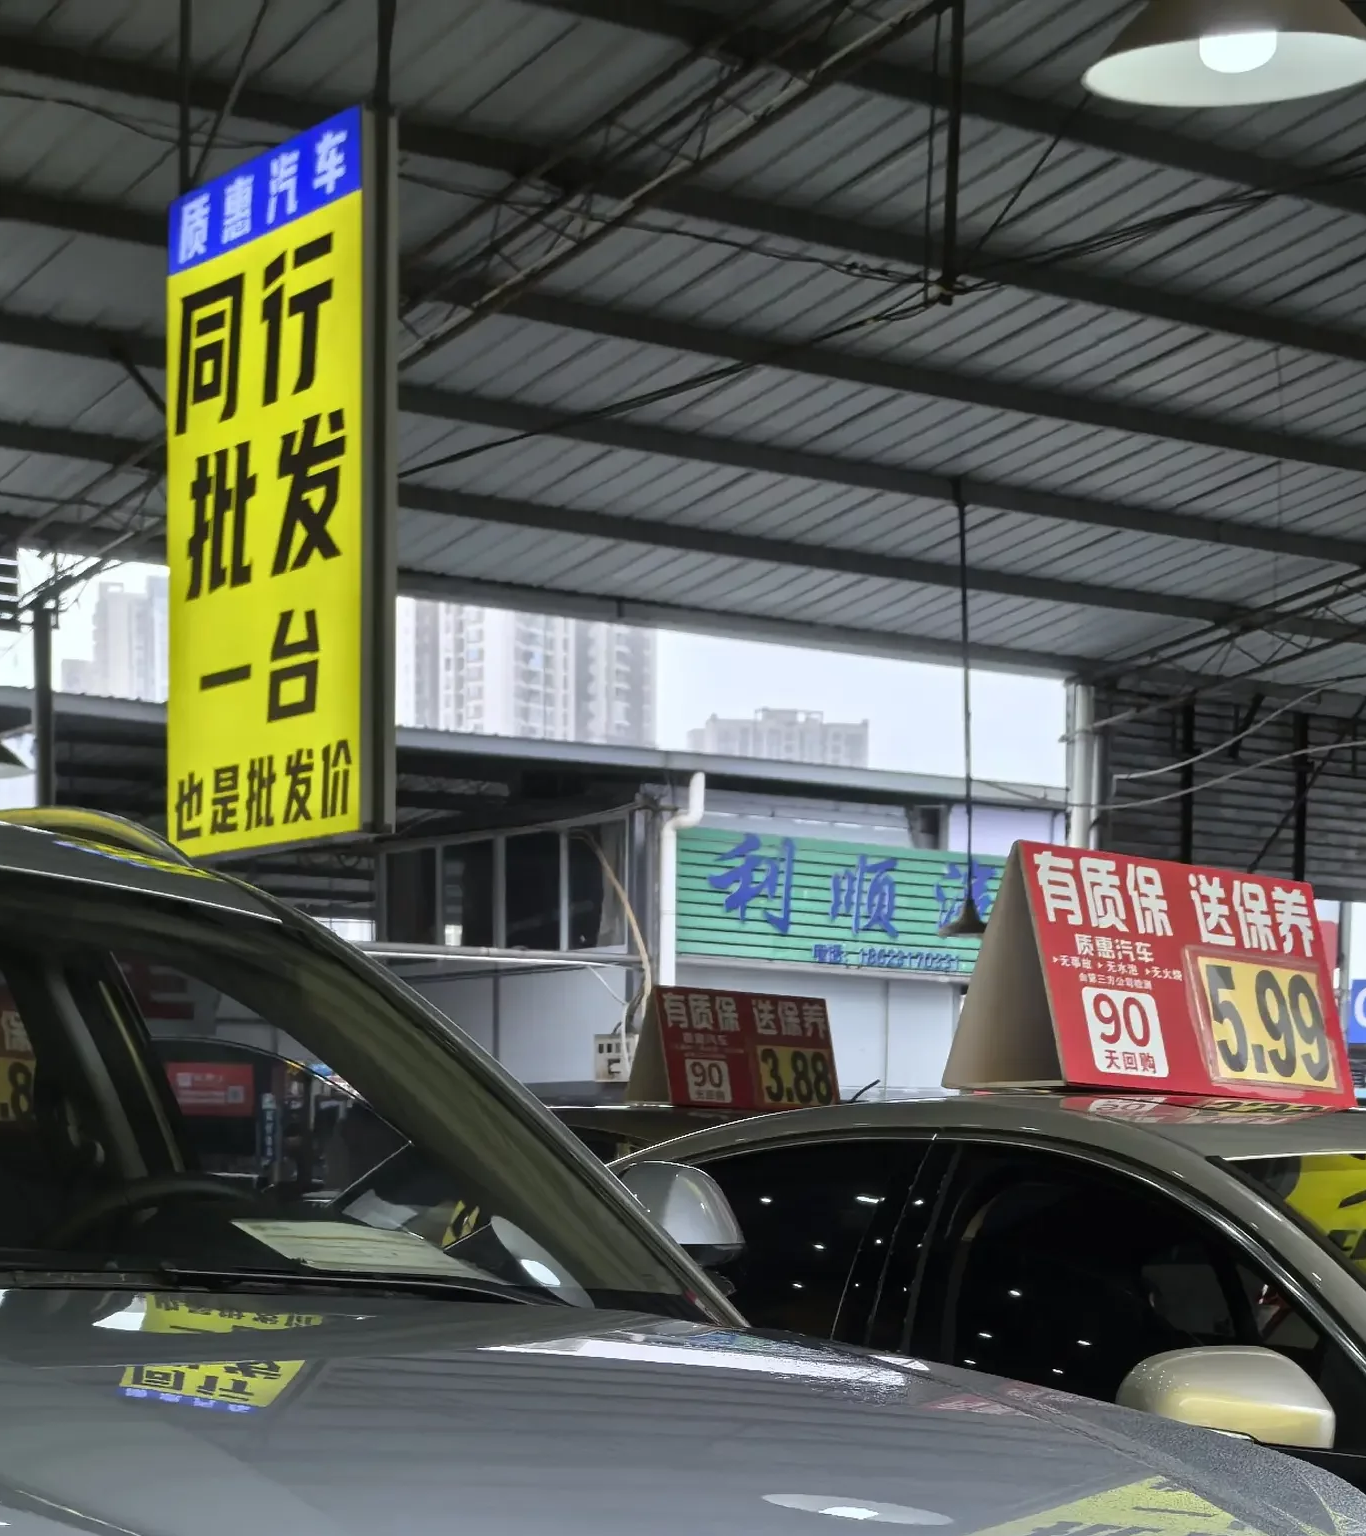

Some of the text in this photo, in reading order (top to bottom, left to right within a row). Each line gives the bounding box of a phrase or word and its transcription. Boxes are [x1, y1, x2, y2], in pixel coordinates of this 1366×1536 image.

[178, 130, 348, 264] 质惠汽车
[175, 231, 334, 436] 同行
[186, 408, 346, 602] 批发
[200, 609, 319, 723] 一台
[175, 739, 352, 842] 也是批发价
[1034, 850, 1314, 957] 有质保 送保养
[1075, 934, 1154, 962] 质惠汽车
[662, 992, 826, 1039] 有质保 送保养
[1093, 993, 1150, 1047] 90
[1206, 964, 1329, 1082] 5.99
[691, 1062, 722, 1088] 90
[761, 1049, 832, 1104] 3.88
